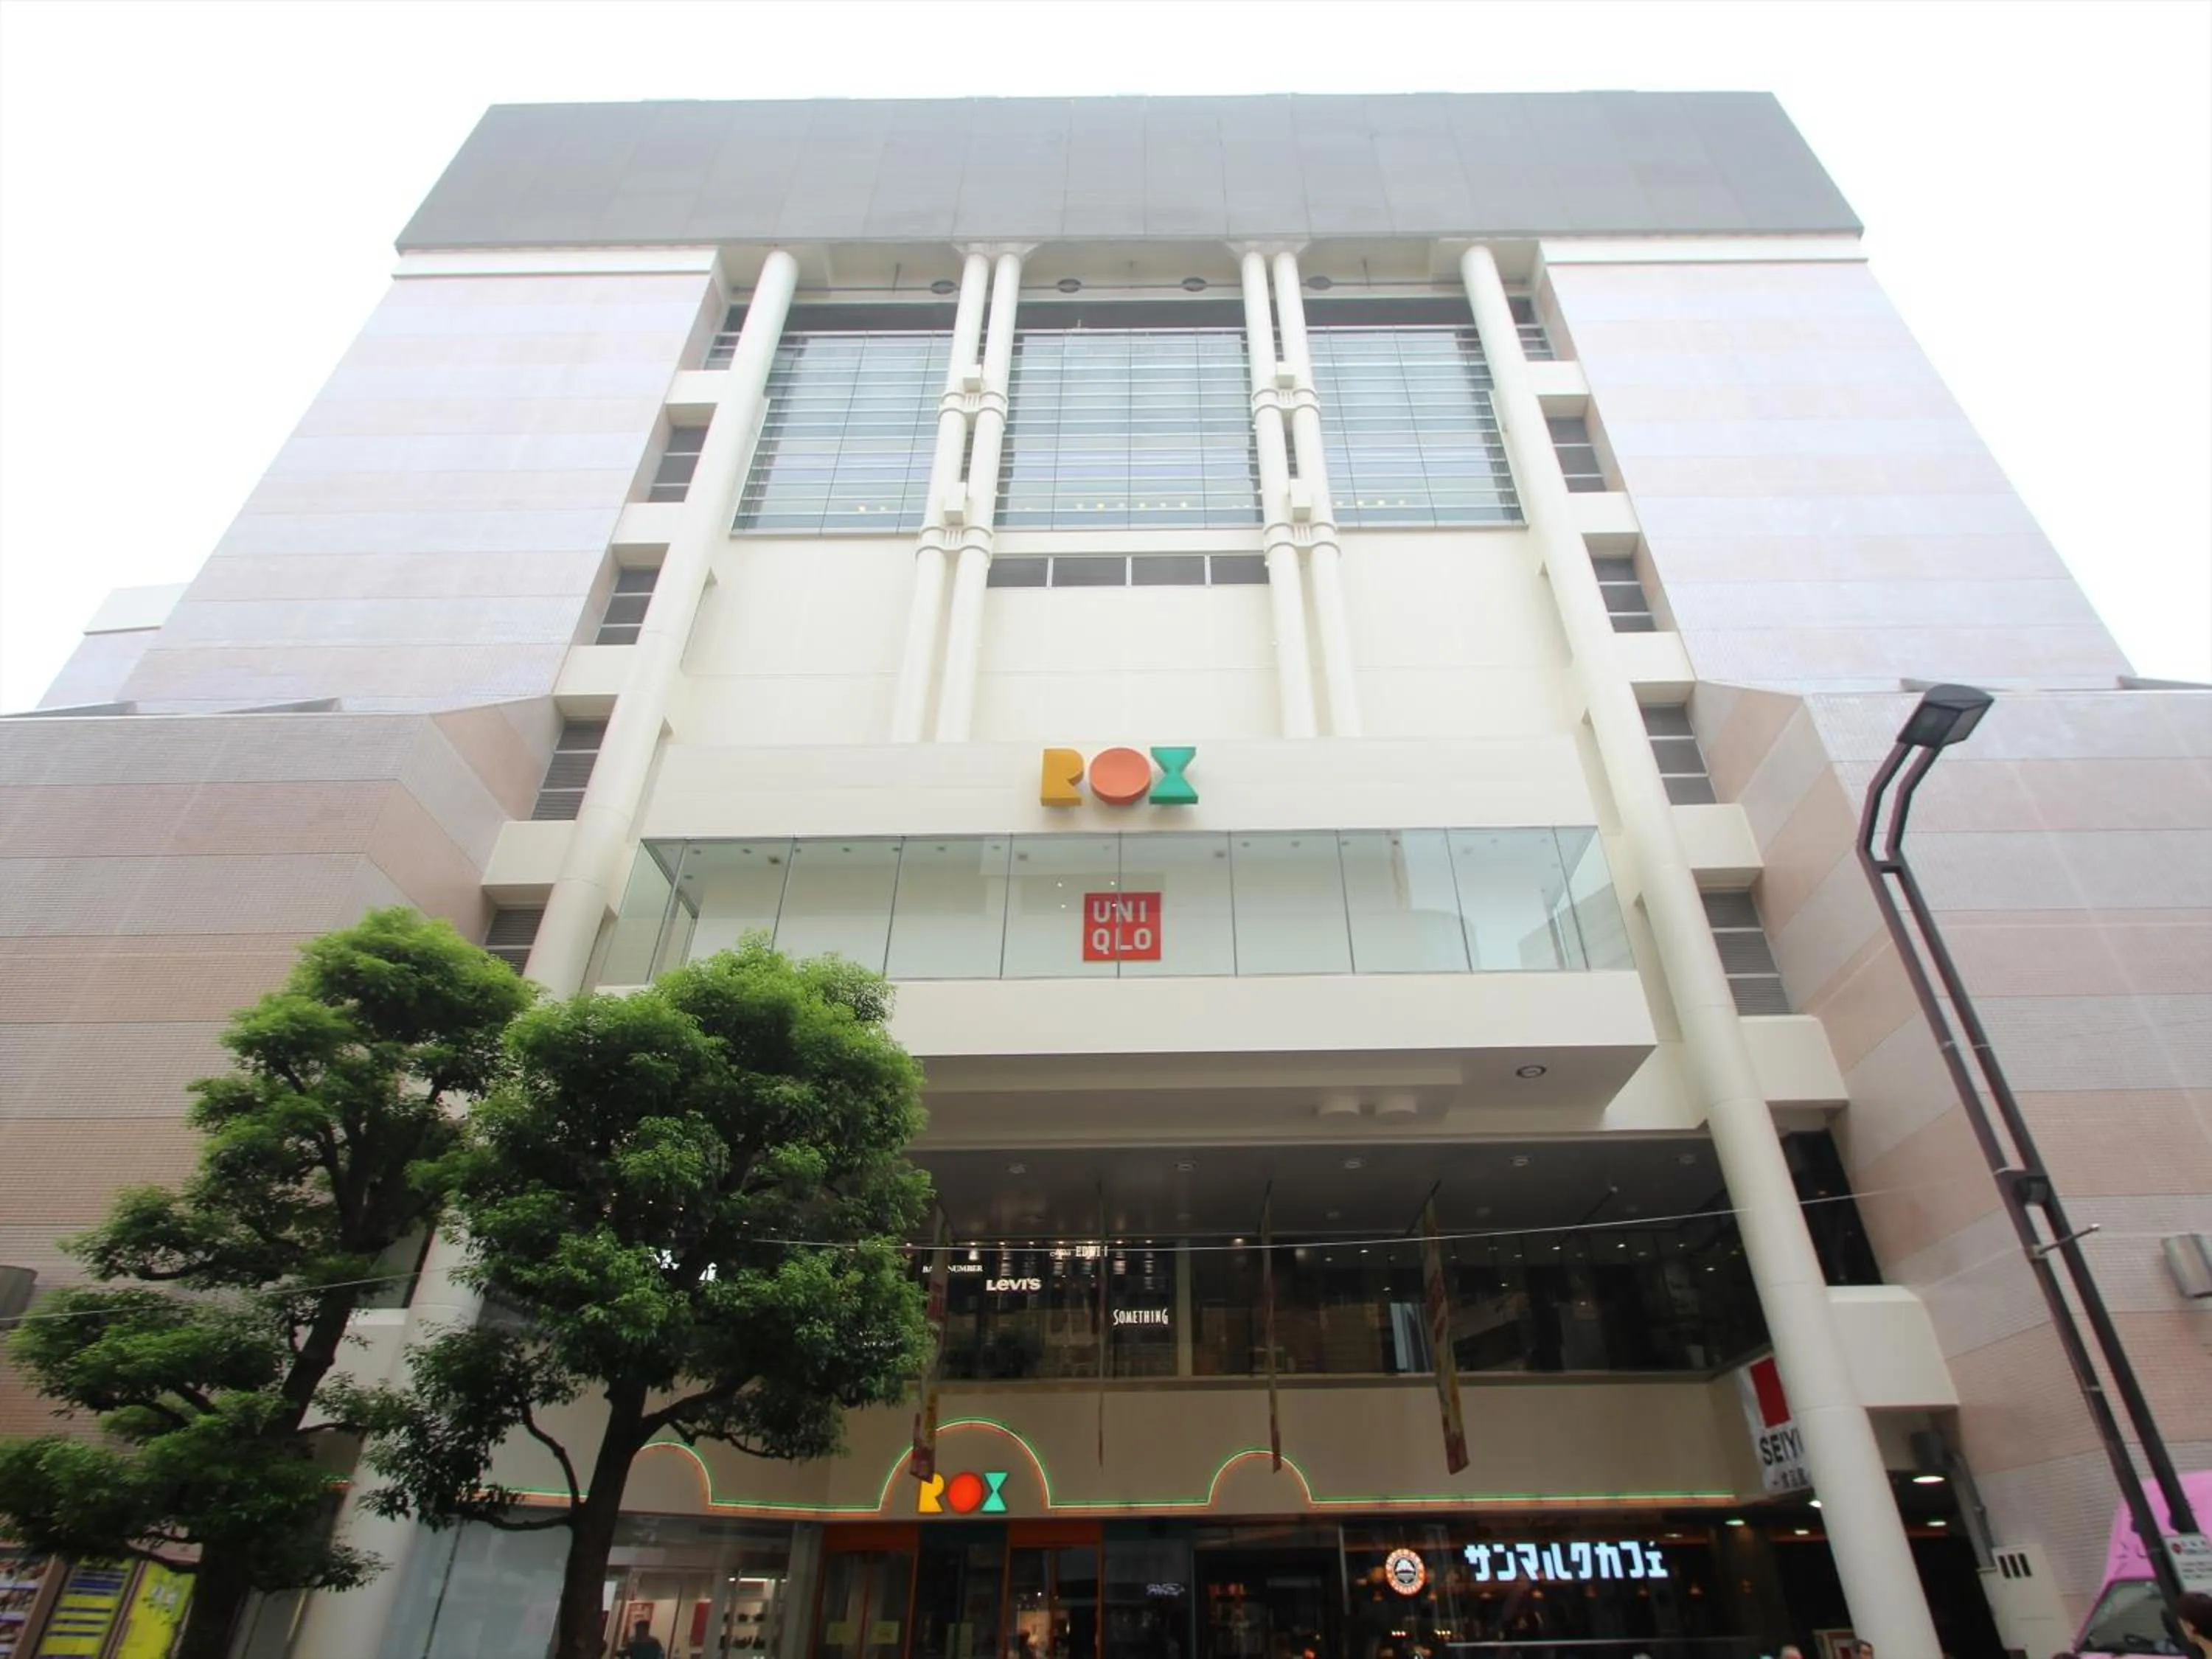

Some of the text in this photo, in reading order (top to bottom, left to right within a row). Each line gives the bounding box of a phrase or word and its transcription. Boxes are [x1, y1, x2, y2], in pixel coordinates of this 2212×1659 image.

[1040, 746, 1198, 807] ROX
[1093, 901, 1147, 922] UNI
[1092, 928, 1152, 953] QLO
[918, 1471, 1009, 1515] ROX
[1464, 1540, 1669, 1582] サンマルクカフェ
